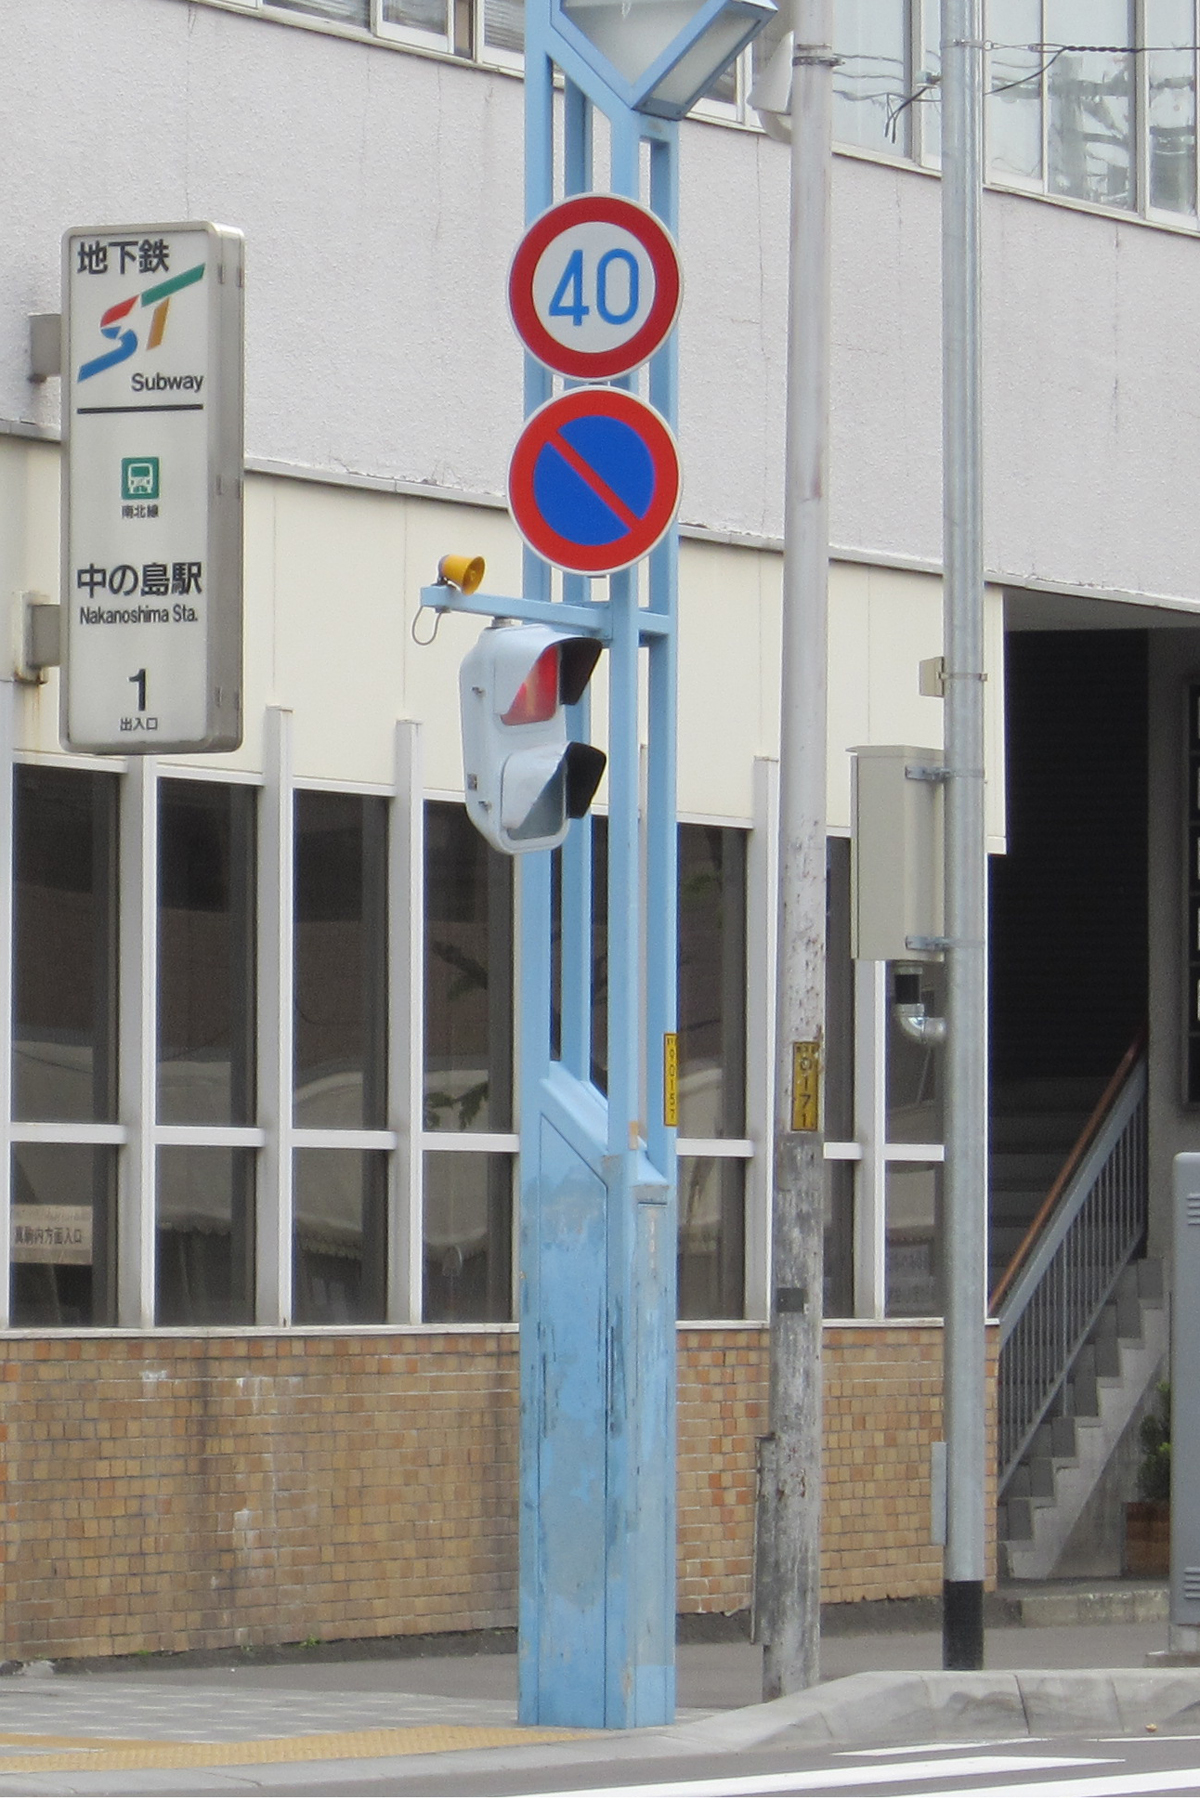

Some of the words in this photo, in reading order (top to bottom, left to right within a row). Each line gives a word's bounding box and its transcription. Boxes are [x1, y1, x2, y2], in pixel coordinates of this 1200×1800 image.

[77, 239, 170, 275] 地下鉄
[548, 248, 640, 327] 40
[131, 372, 204, 393] Subway
[121, 505, 160, 519] 南北線
[76, 562, 203, 599] 中の島駅
[79, 605, 170, 625] Nakanoshima
[173, 603, 199, 623] Sta.
[128, 668, 147, 712] 1
[120, 718, 159, 732] 出入口
